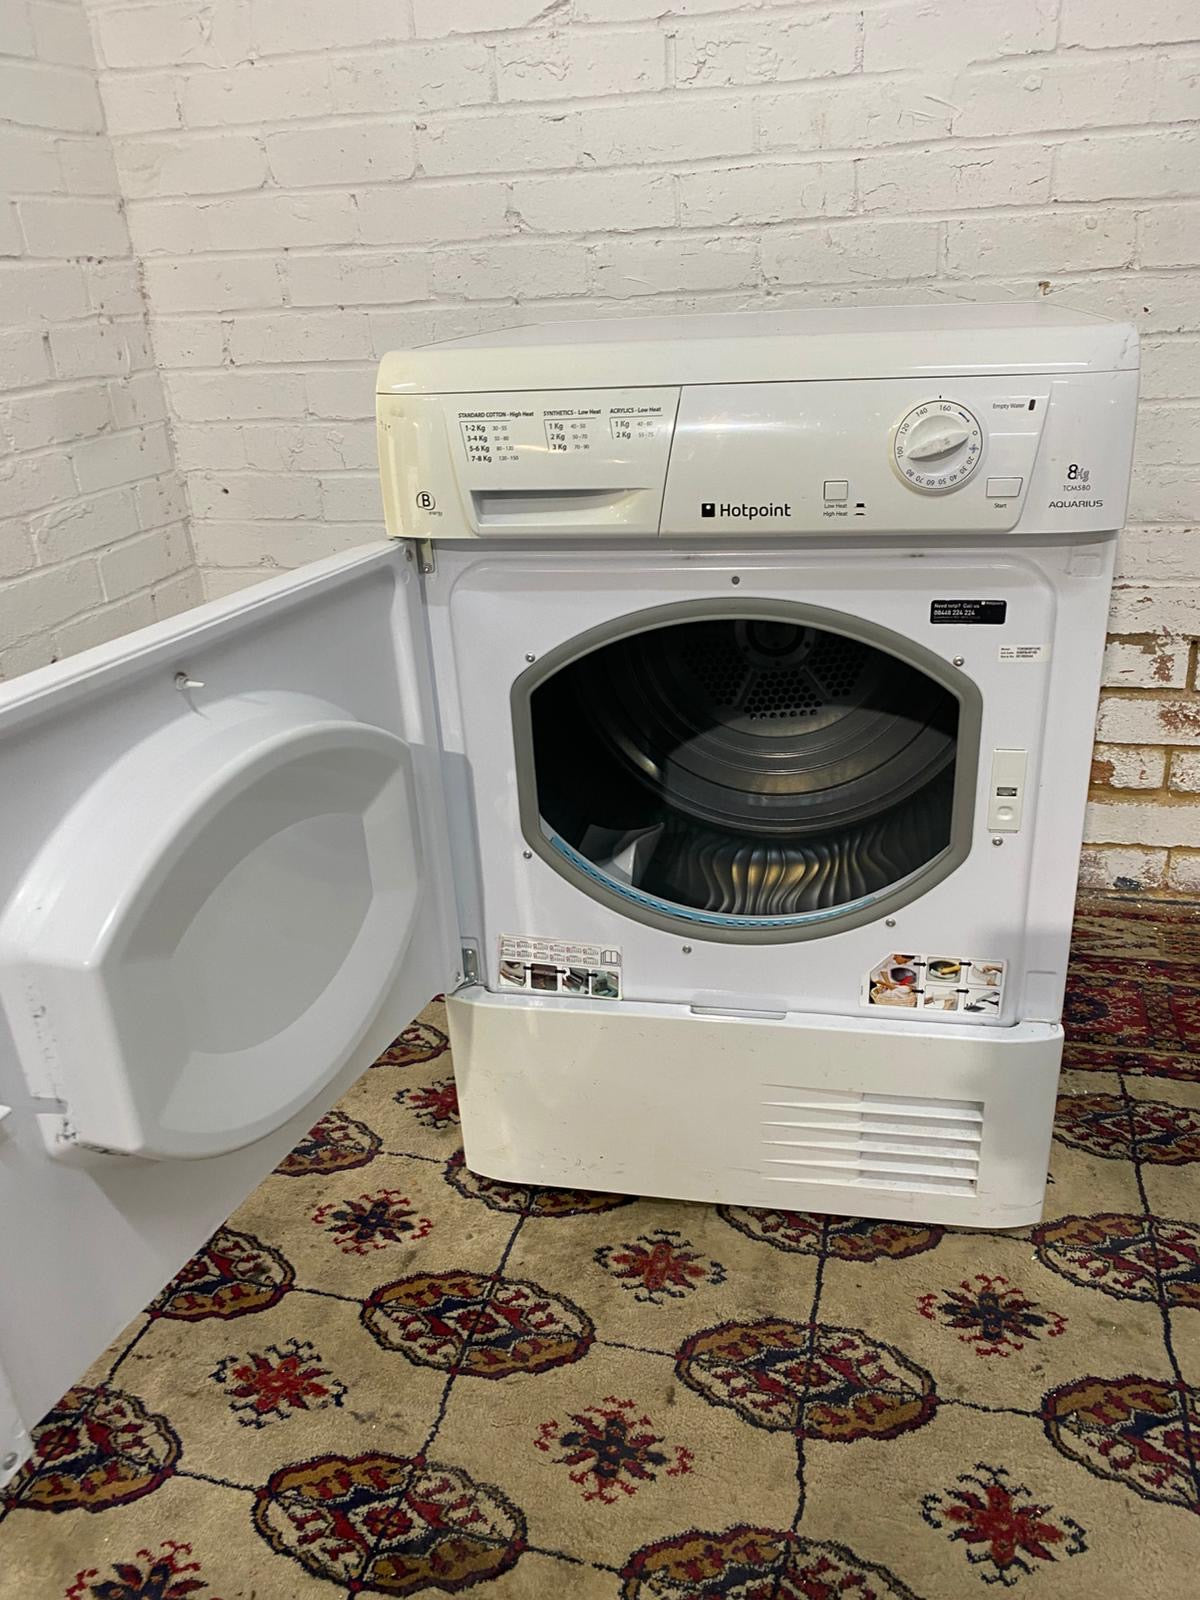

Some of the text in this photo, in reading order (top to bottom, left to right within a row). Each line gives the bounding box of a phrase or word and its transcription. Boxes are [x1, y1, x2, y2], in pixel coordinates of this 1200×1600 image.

[915, 407, 928, 417] 140
[940, 404, 952, 412] 160
[476, 424, 486, 432] Kg
[554, 422, 564, 431] Kg
[620, 420, 630, 429] Kg
[899, 422, 910, 435] 120
[478, 435, 488, 443] Kg
[555, 433, 566, 441] Kg
[621, 431, 631, 440] Kg
[480, 445, 490, 453] Kg
[557, 443, 567, 451] Kg
[896, 446, 904, 459] 100
[482, 455, 492, 463] Kg
[966, 456, 975, 465] 20
[906, 468, 915, 477] 80
[959, 465, 968, 475] 30
[915, 475, 925, 483] 70
[938, 477, 947, 485] 50
[949, 474, 958, 482] 40
[421, 493, 431, 507] B
[1048, 500, 1104, 508] AQUARIUS
[720, 502, 792, 520] Hotpoint
